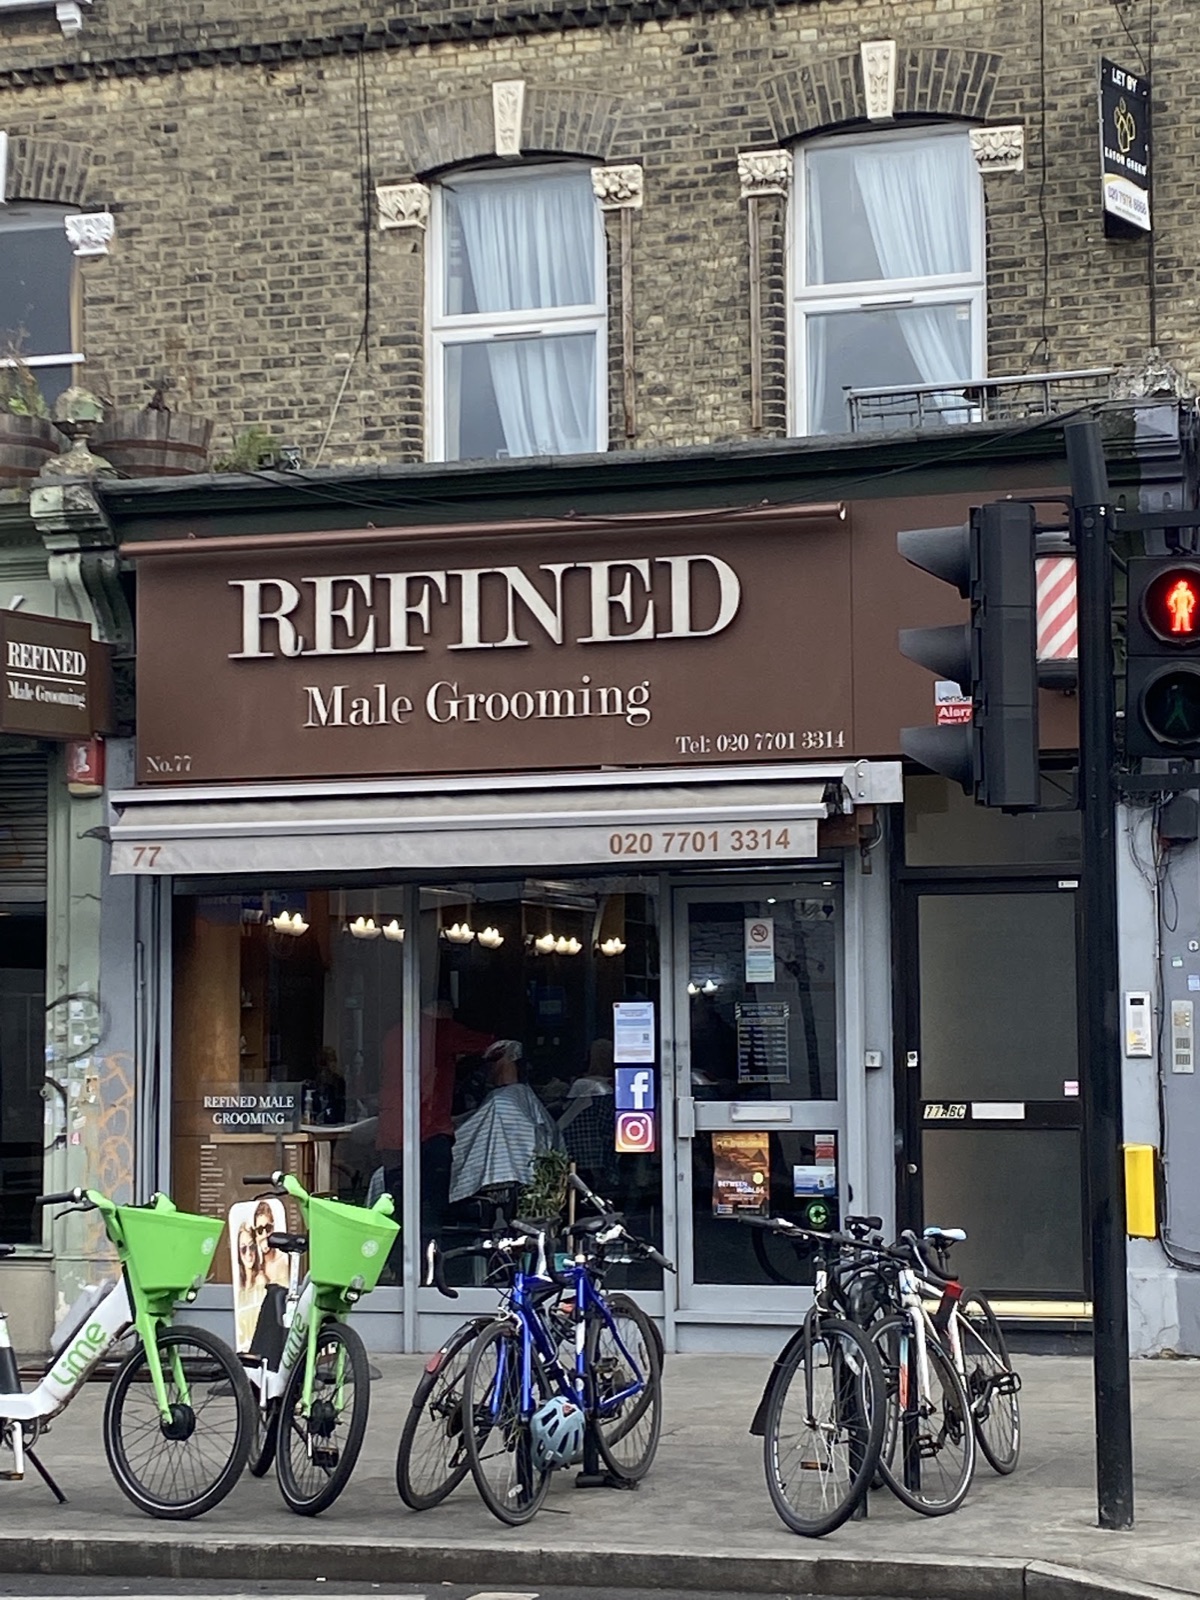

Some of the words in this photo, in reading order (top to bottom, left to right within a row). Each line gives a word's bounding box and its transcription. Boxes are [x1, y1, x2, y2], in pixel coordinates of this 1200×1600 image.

[1112, 67, 1126, 87] LET
[228, 554, 740, 658] REFINED
[6, 641, 86, 676] REFINED
[8, 680, 34, 700] Male
[35, 685, 86, 711] Grooming
[302, 684, 413, 727] Male
[426, 675, 651, 727] Grooming
[675, 735, 711, 754] Tel:
[716, 733, 749, 752] 020
[754, 732, 795, 750] 7701
[801, 731, 845, 749] 3314
[146, 755, 192, 773] No.77
[609, 833, 653, 855] 020
[662, 831, 719, 853] 7701
[730, 828, 790, 852] 3314
[133, 846, 162, 867] 77
[203, 1096, 257, 1109] REFINED
[258, 1096, 294, 1108] MALE
[212, 1112, 285, 1125] GROOMING
[51, 1321, 108, 1387] Lime
